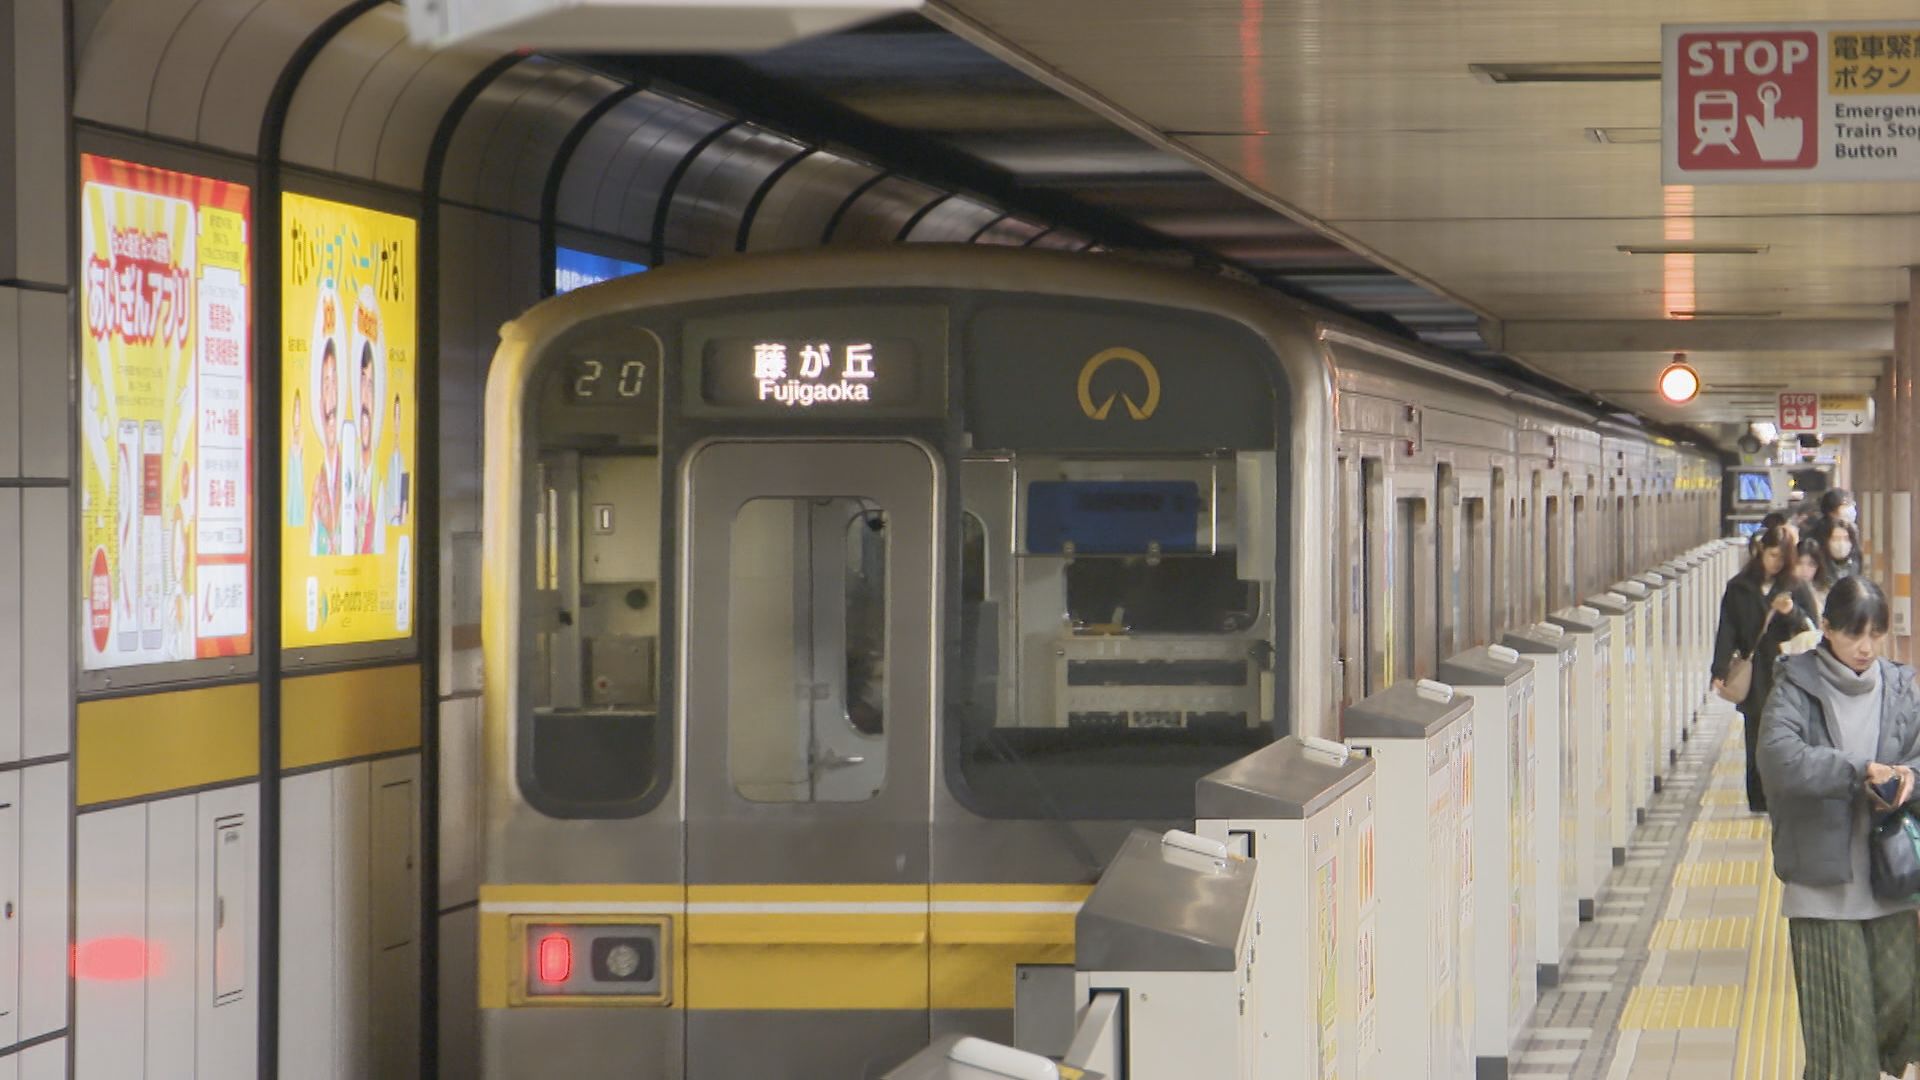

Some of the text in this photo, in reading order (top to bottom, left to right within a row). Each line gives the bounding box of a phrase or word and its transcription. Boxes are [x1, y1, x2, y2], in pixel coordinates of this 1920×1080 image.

[1687, 40, 1809, 76] STOP
[1833, 34, 1920, 61] 電車緊
[1834, 64, 1911, 88] ボタン
[1835, 103, 1920, 121] Emergen
[1835, 123, 1920, 141] Train Sto
[1835, 144, 1897, 159] Button
[87, 258, 191, 346] あいぎんアプリ
[753, 343, 876, 379] 藤が丘
[574, 356, 646, 397] 20
[758, 379, 870, 405] Fujigaoka
[1782, 394, 1816, 406] STOP
